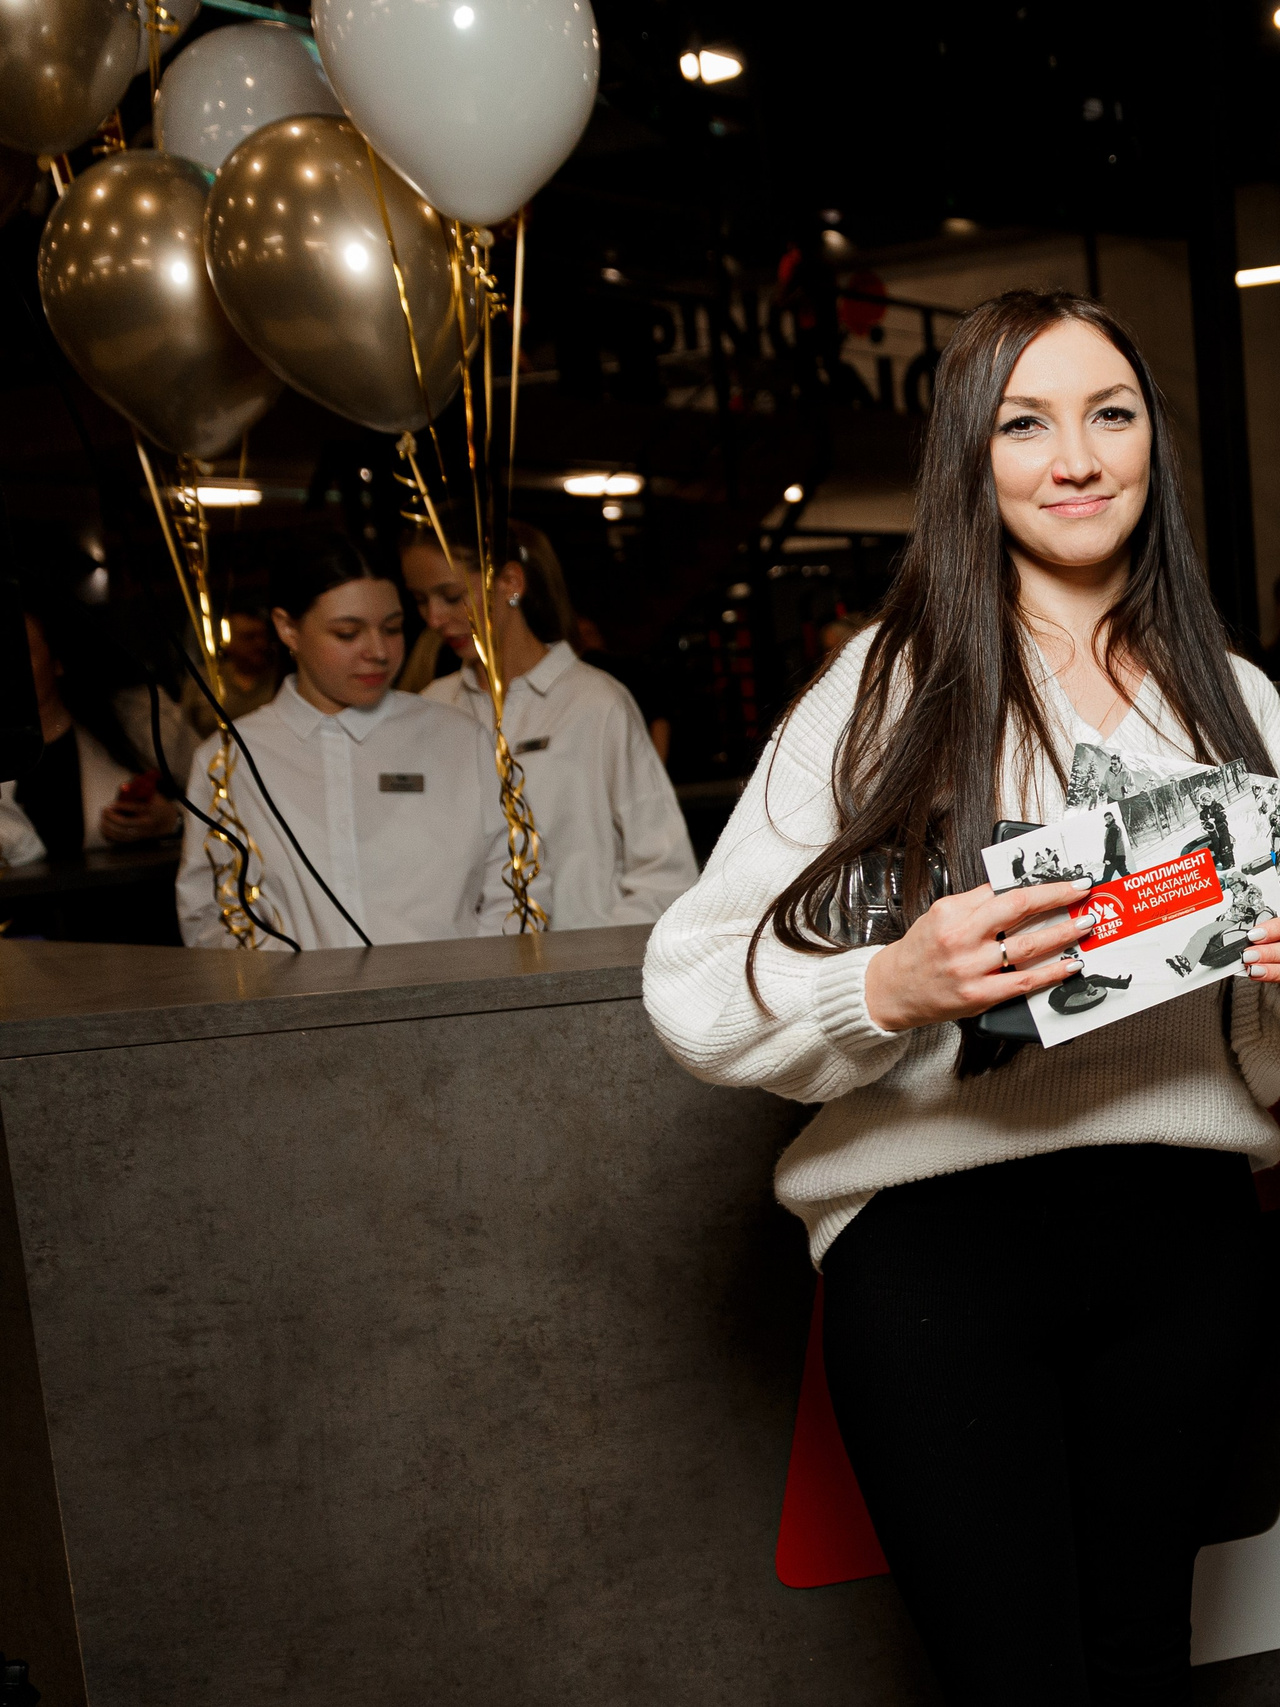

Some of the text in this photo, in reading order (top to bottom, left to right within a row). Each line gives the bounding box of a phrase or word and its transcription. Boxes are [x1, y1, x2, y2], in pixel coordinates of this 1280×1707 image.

[1123, 853, 1206, 891] КОМПЛИМЕНТ
[1137, 869, 1201, 900] НА КАТАНИЕ
[1132, 901, 1150, 914] НА
[1149, 877, 1212, 908] ВАТРУШКАХ
[1098, 928, 1118, 940] ПАРК
